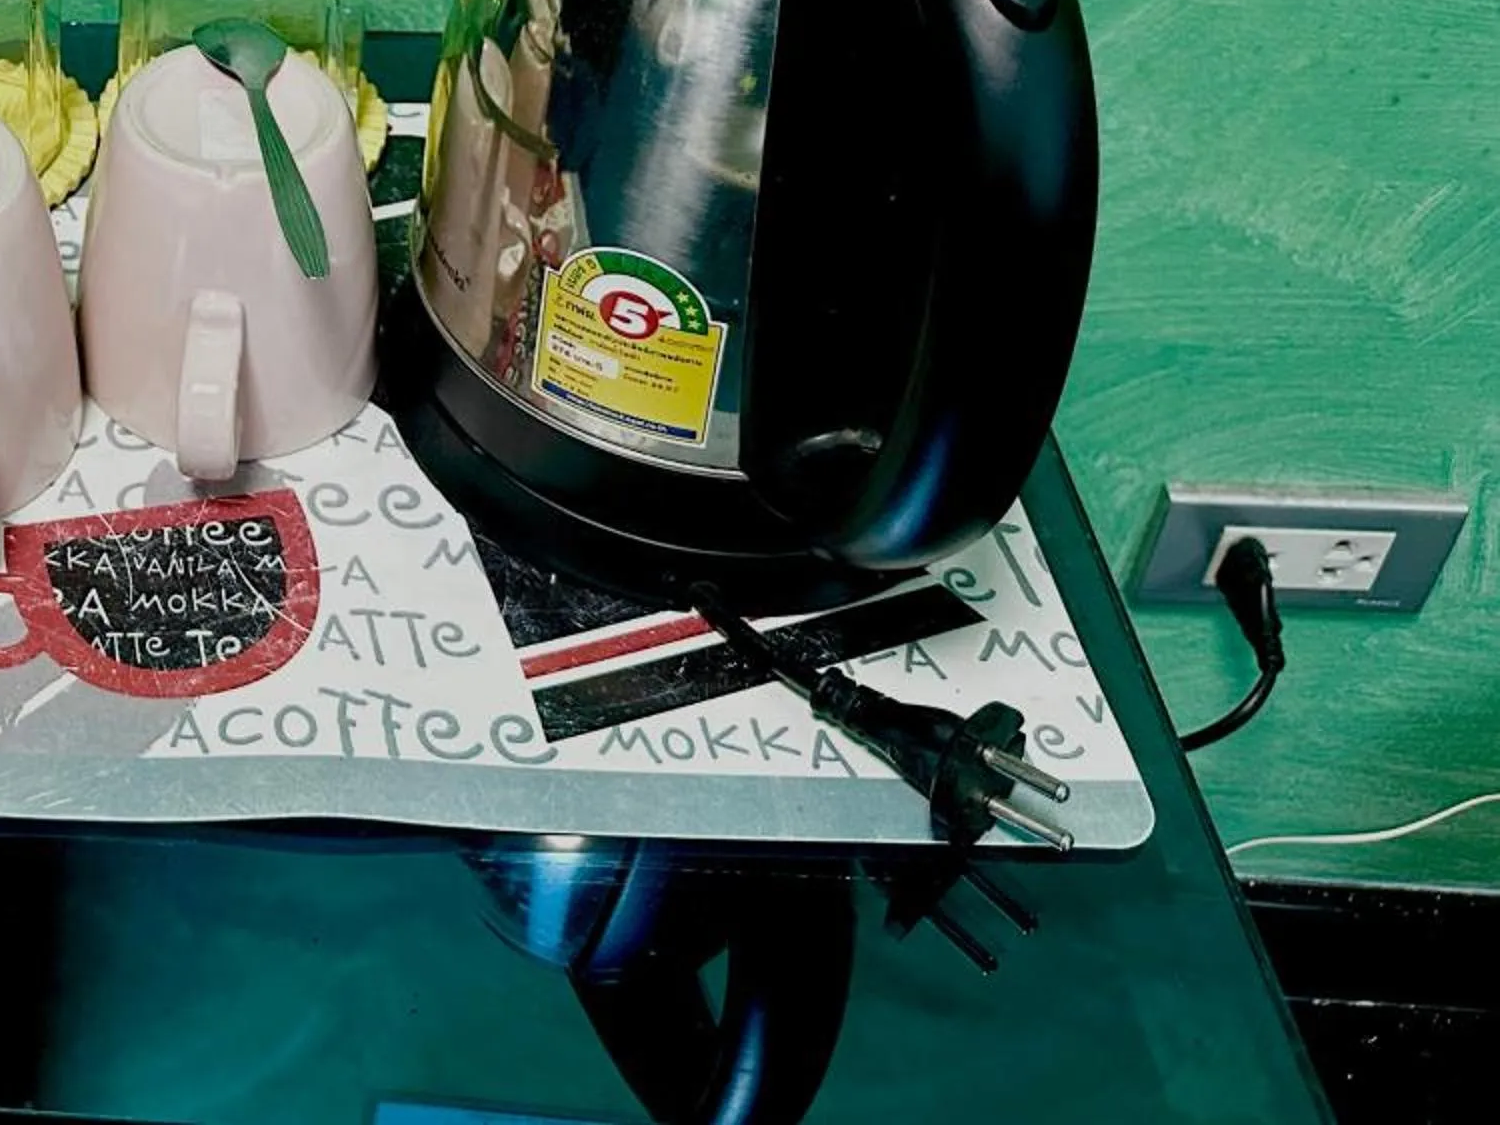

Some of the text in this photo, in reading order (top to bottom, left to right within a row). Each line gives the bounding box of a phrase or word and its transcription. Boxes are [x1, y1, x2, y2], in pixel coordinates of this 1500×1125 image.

[609, 295, 649, 335] 5
[130, 587, 276, 621] MOKKA
[599, 717, 858, 777] MOKKA
